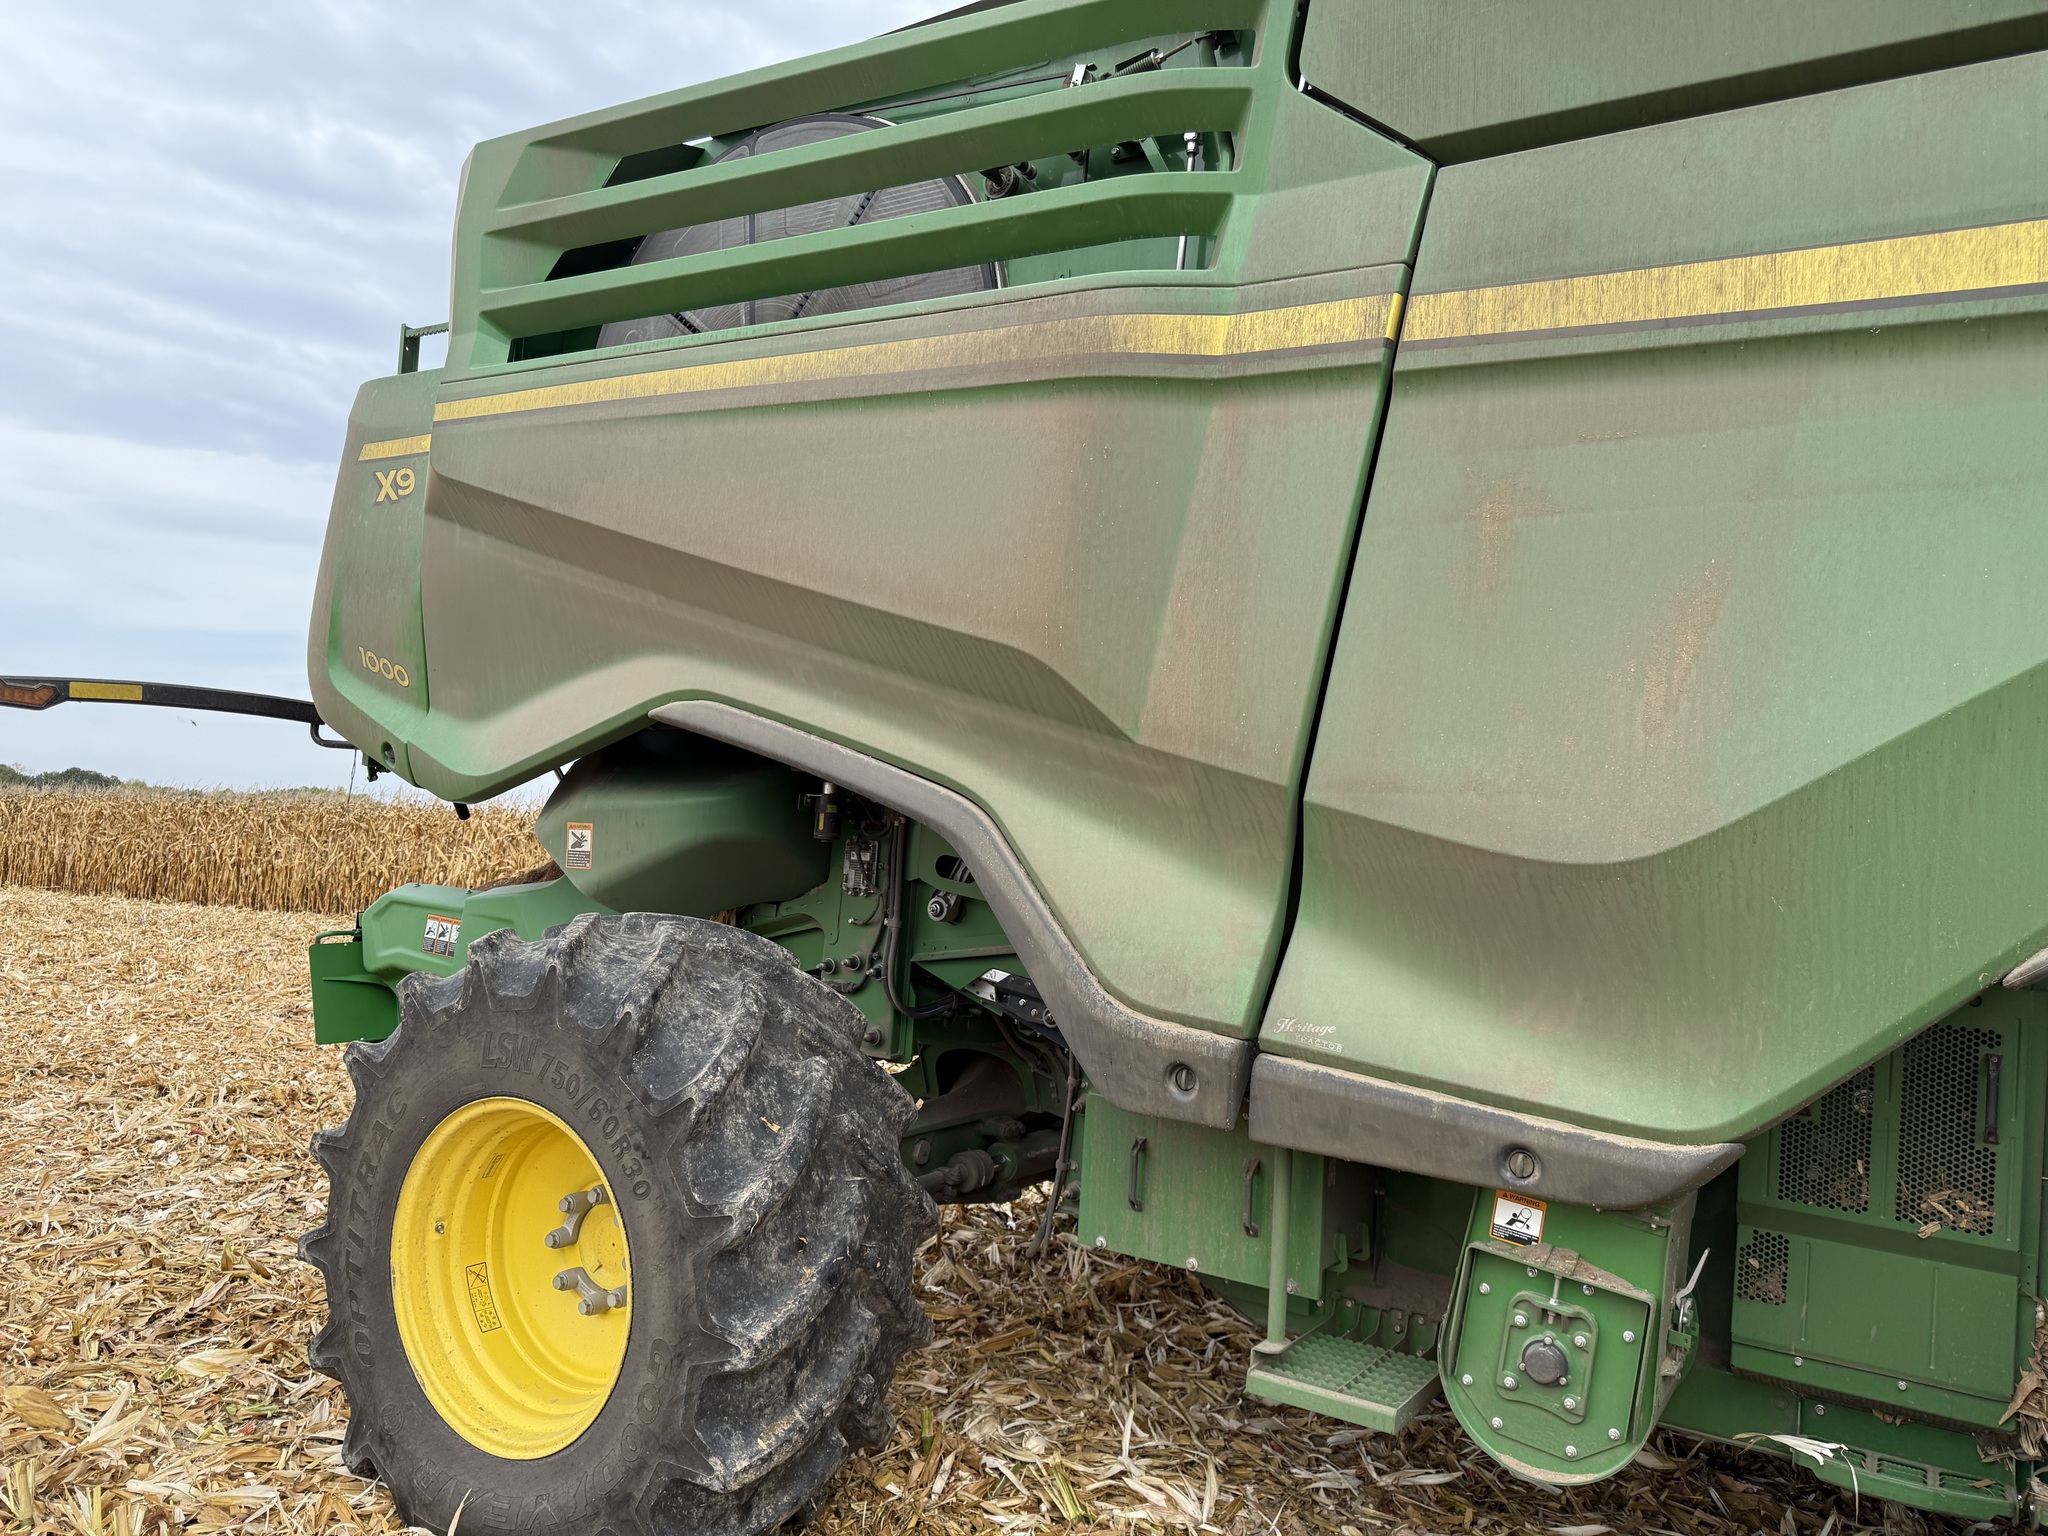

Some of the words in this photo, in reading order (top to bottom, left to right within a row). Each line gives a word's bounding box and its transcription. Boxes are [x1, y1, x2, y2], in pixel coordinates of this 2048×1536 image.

[374, 467, 416, 503] X9
[358, 646, 410, 688] 1000
[1274, 1017, 1337, 1036] Heritage
[1295, 1034, 1344, 1053] TRACTOR
[481, 1030, 540, 1074] LSW
[1510, 1193, 1540, 1208] WARNING
[346, 1086, 408, 1369] OPTITRAC
